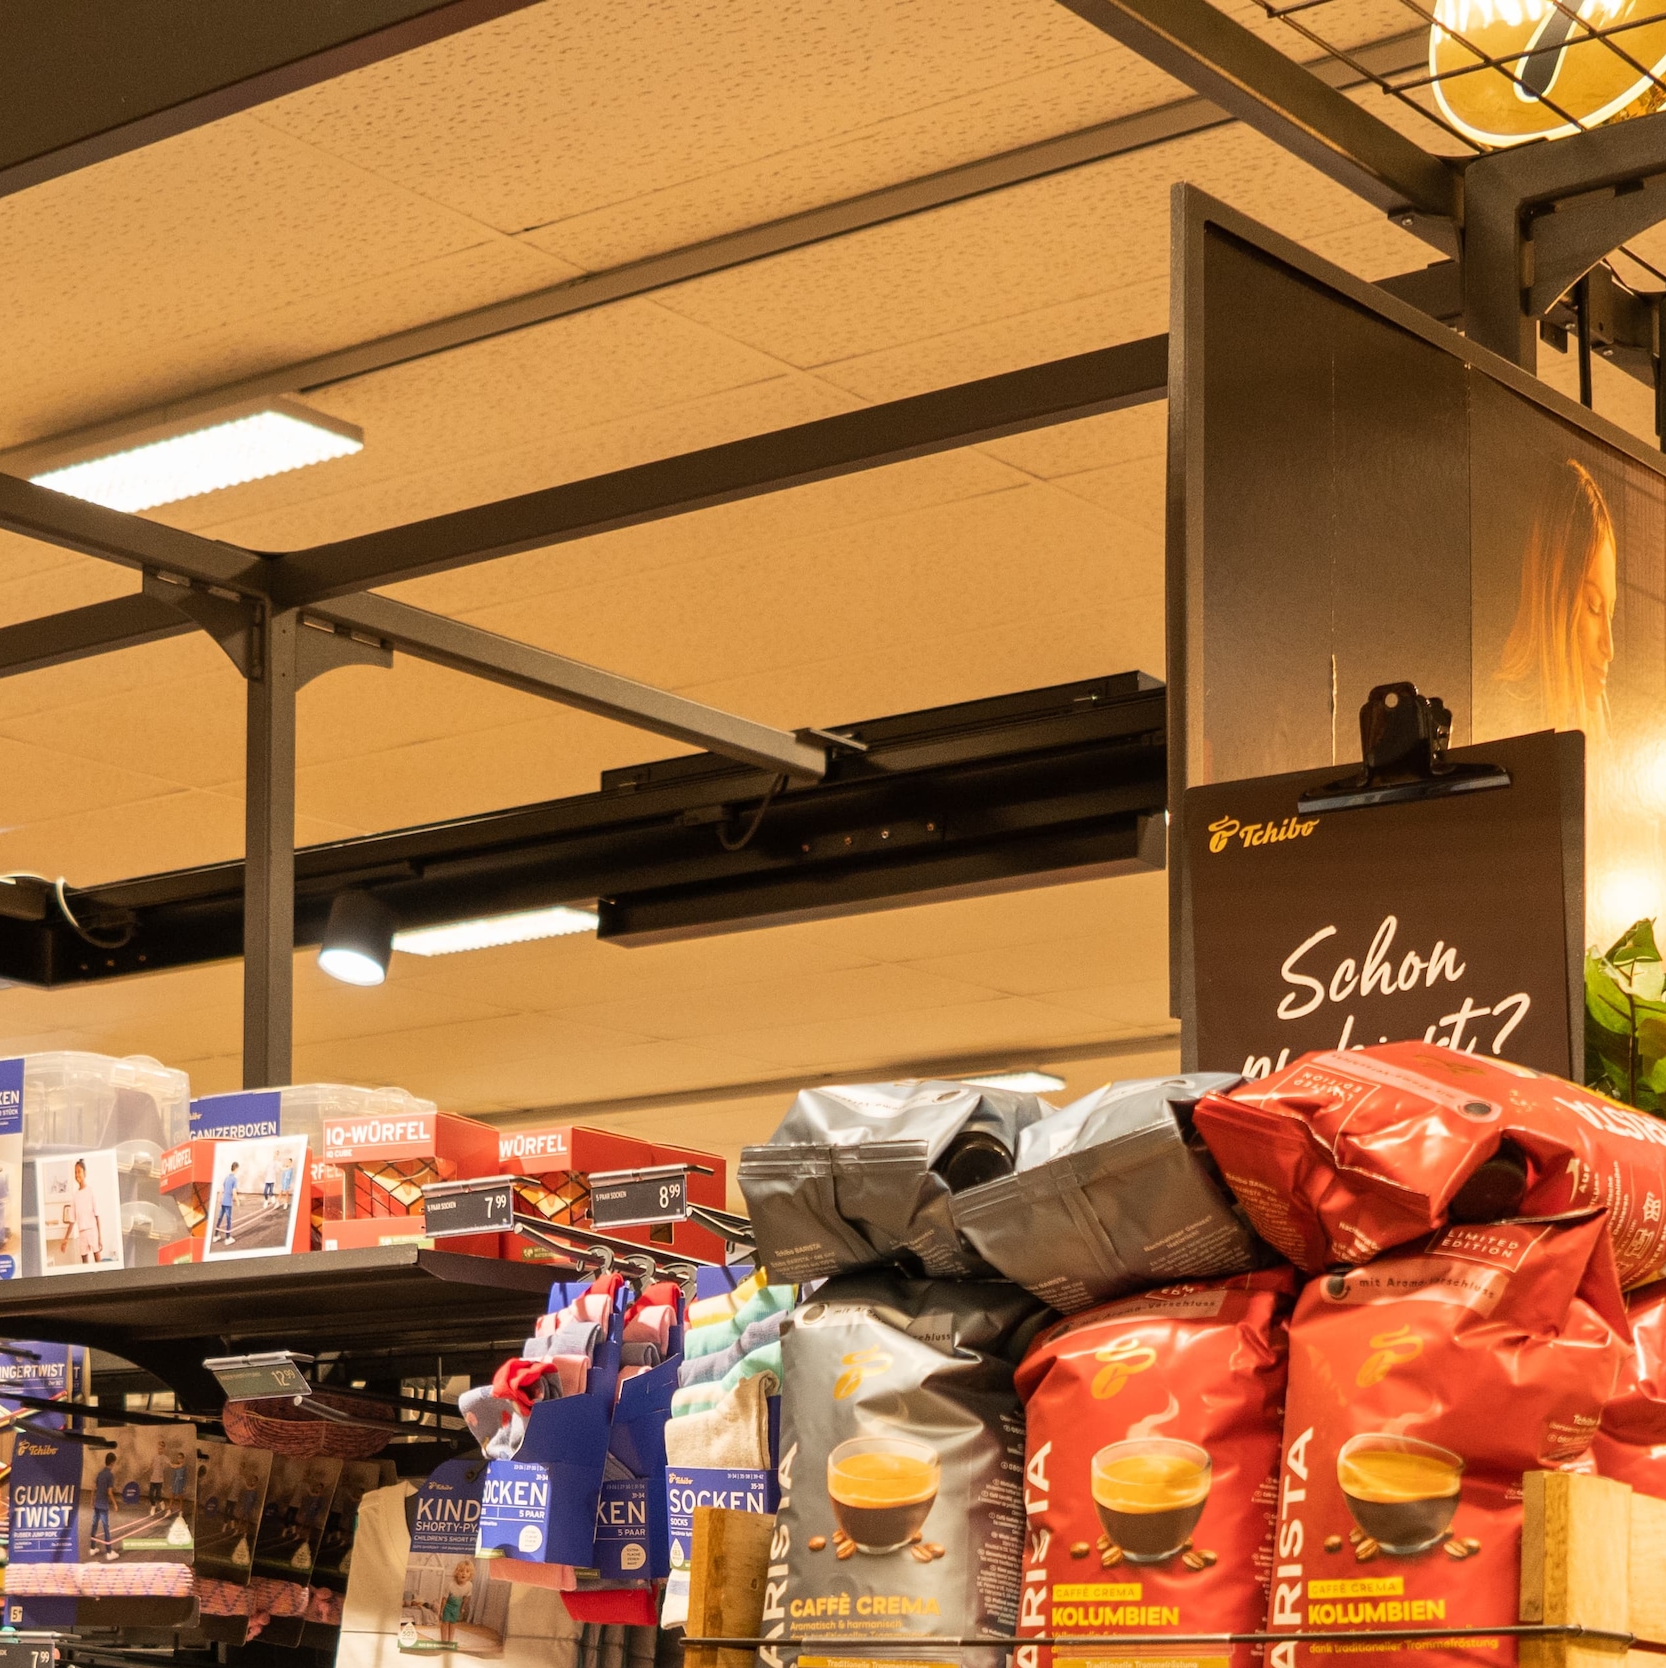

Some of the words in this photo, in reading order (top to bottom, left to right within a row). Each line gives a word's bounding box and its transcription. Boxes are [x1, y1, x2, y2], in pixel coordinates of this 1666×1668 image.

[1239, 818, 1320, 848] Tchibo
[1277, 915, 1466, 1020] Schon
[326, 1120, 430, 1145] IQ-WÜRFEL
[500, 1134, 567, 1158] WÜRFEL
[1442, 1237, 1513, 1259] EDITION
[1449, 1229, 1519, 1250] LIMITED
[15, 1485, 75, 1505] GUMMI
[15, 1506, 73, 1528] TWIST
[790, 1594, 849, 1618] CAFFÈ
[855, 1597, 940, 1615] CREMA
[1052, 1607, 1179, 1628] KOLUMBIEN
[1308, 1600, 1445, 1625] KOLUMBIEN
